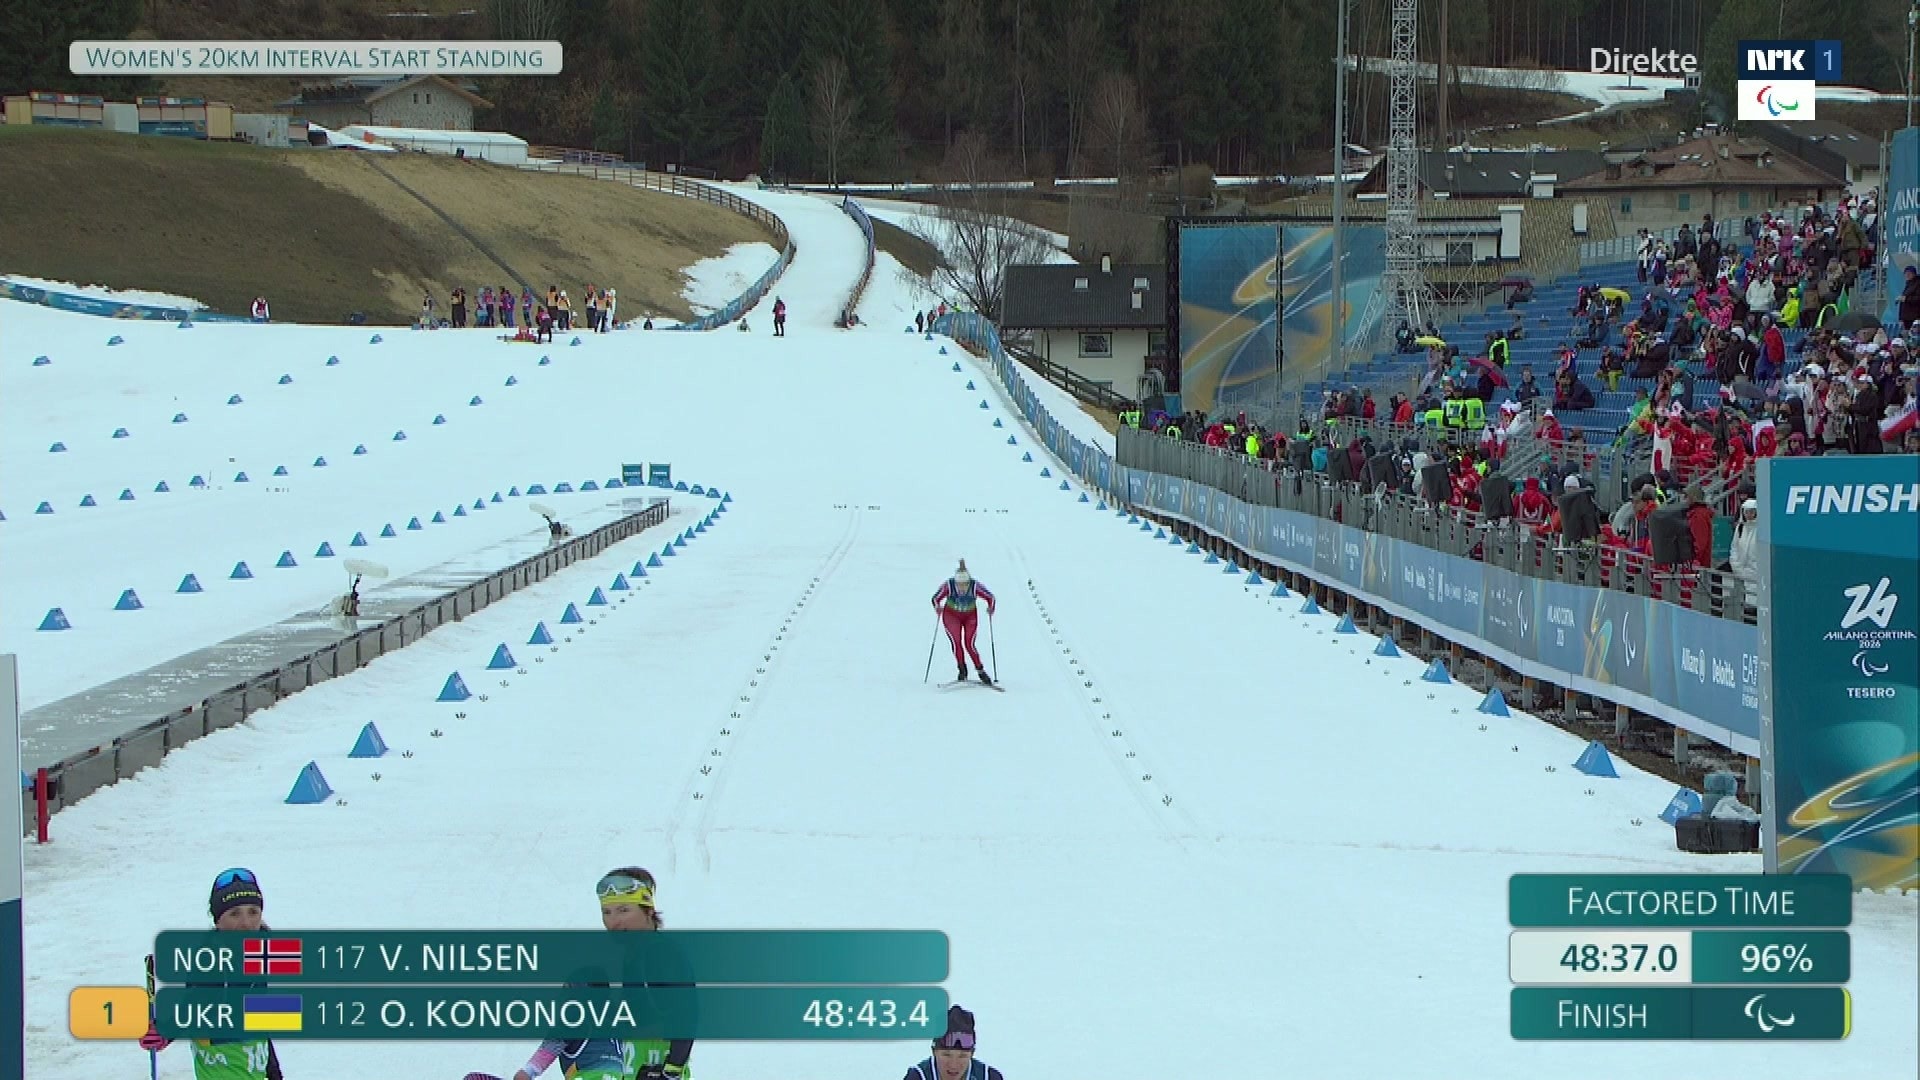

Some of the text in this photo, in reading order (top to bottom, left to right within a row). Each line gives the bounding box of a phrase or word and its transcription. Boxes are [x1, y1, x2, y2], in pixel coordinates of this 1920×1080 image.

[1785, 483, 1920, 515] FINISH
[1823, 631, 1917, 641] MILANO CORTINA
[1859, 640, 1881, 649] 2026
[1846, 687, 1896, 699] TESERO
